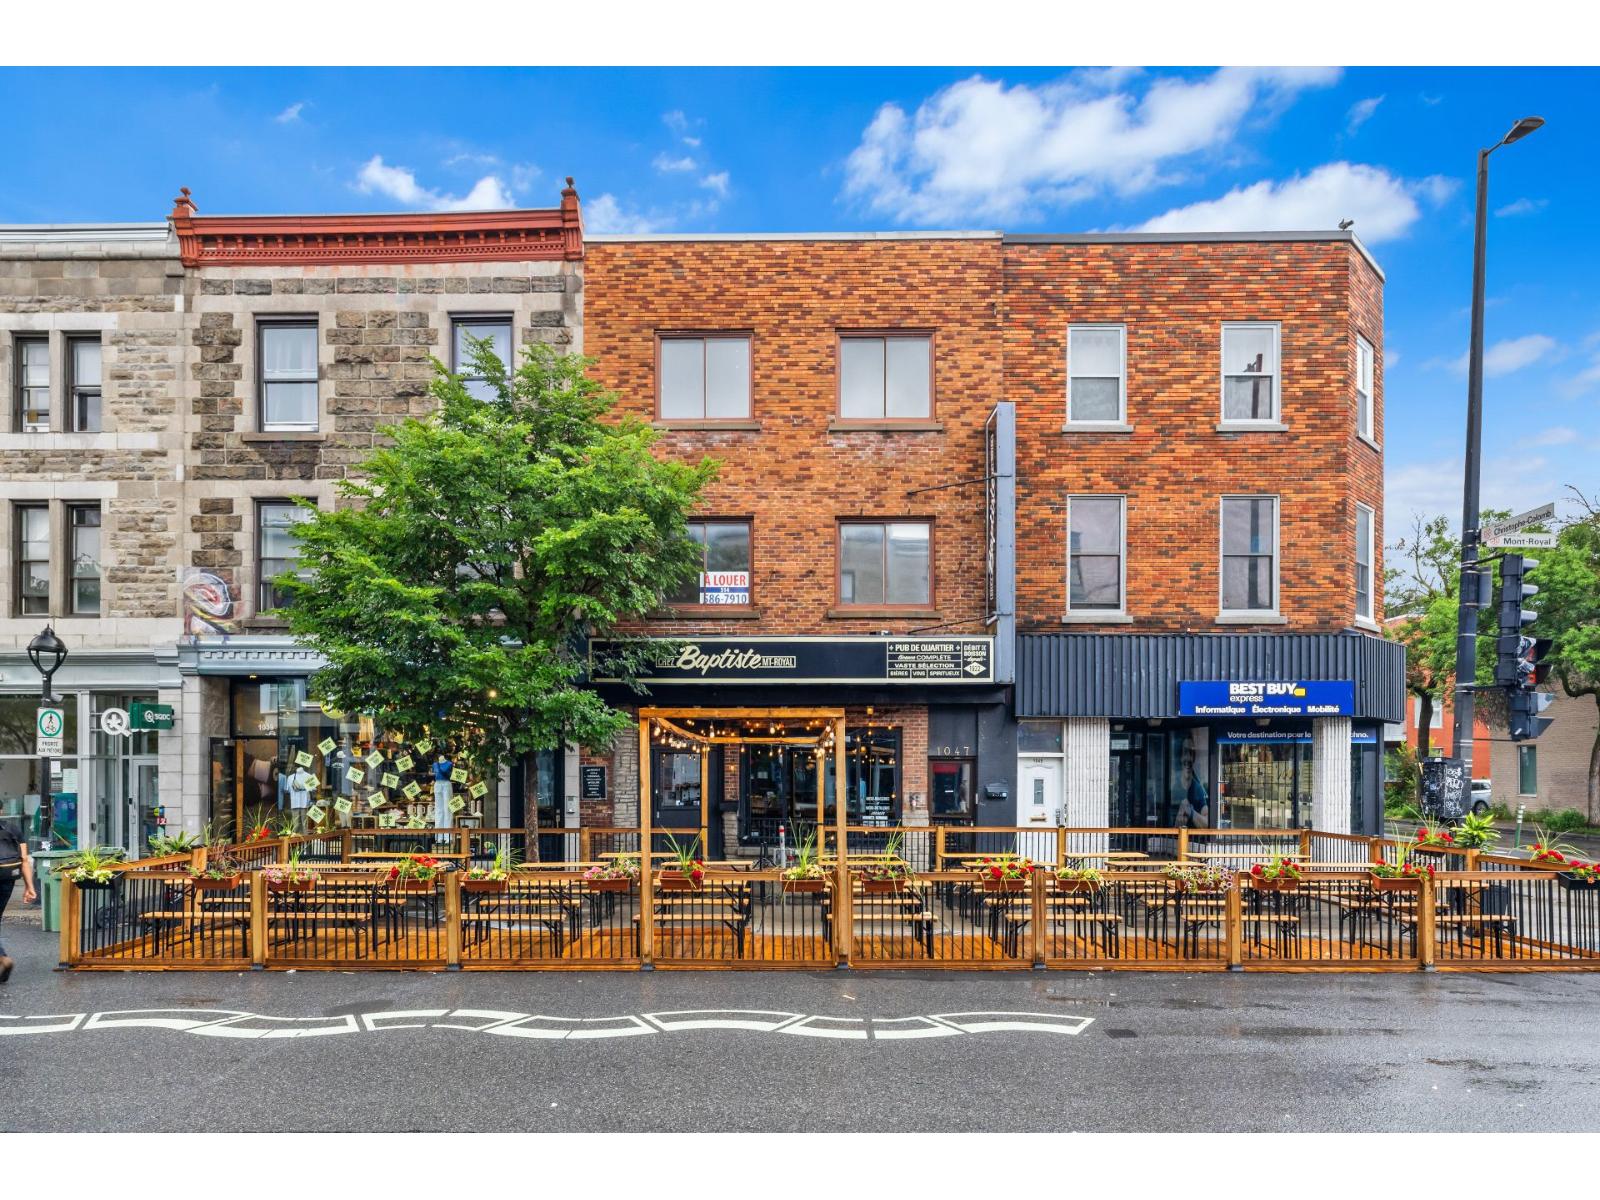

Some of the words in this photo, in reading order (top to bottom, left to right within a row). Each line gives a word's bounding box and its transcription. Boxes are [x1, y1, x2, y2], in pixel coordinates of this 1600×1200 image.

[1494, 511, 1551, 535] Christophe-Colomb
[713, 575, 746, 586] LOUER
[895, 644, 909, 652] PUB
[910, 644, 920, 652] DE
[921, 644, 954, 652] QUARTIER
[679, 645, 762, 675] Baptiste
[762, 658, 794, 667] MT-ROYAL
[1229, 683, 1265, 695] BEST
[1266, 683, 1297, 695] BUY
[1229, 695, 1264, 703] express
[1195, 705, 1246, 714] Informatique
[1252, 704, 1302, 714] Électronique
[1307, 705, 1340, 713] Mobilité
[1287, 732, 1303, 740] pour
[937, 746, 969, 756] 1047
